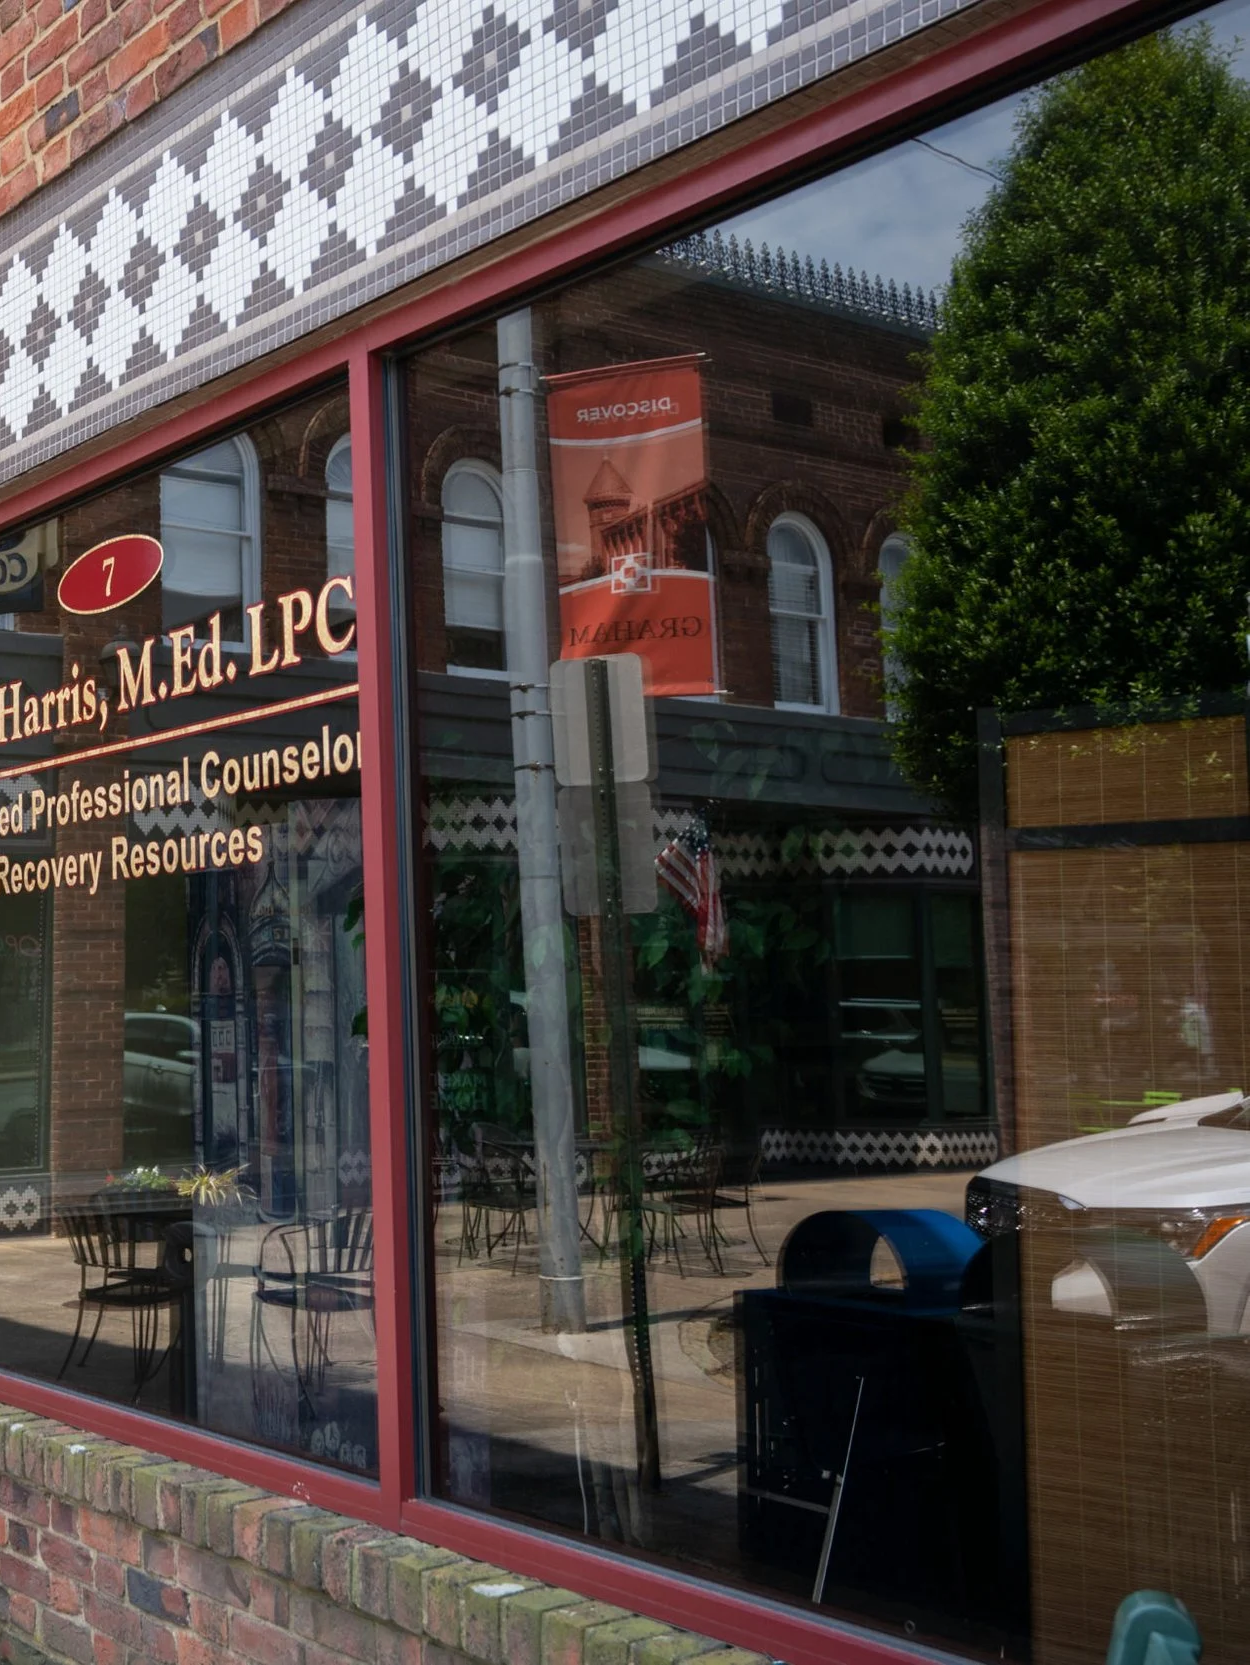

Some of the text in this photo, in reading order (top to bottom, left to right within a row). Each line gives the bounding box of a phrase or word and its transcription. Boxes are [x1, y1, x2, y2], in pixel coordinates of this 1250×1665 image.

[102, 556, 115, 597] 7
[116, 614, 238, 713] M.Ed.
[246, 575, 356, 677] LPC
[30, 756, 190, 831] Professional
[111, 825, 264, 881] Resources
